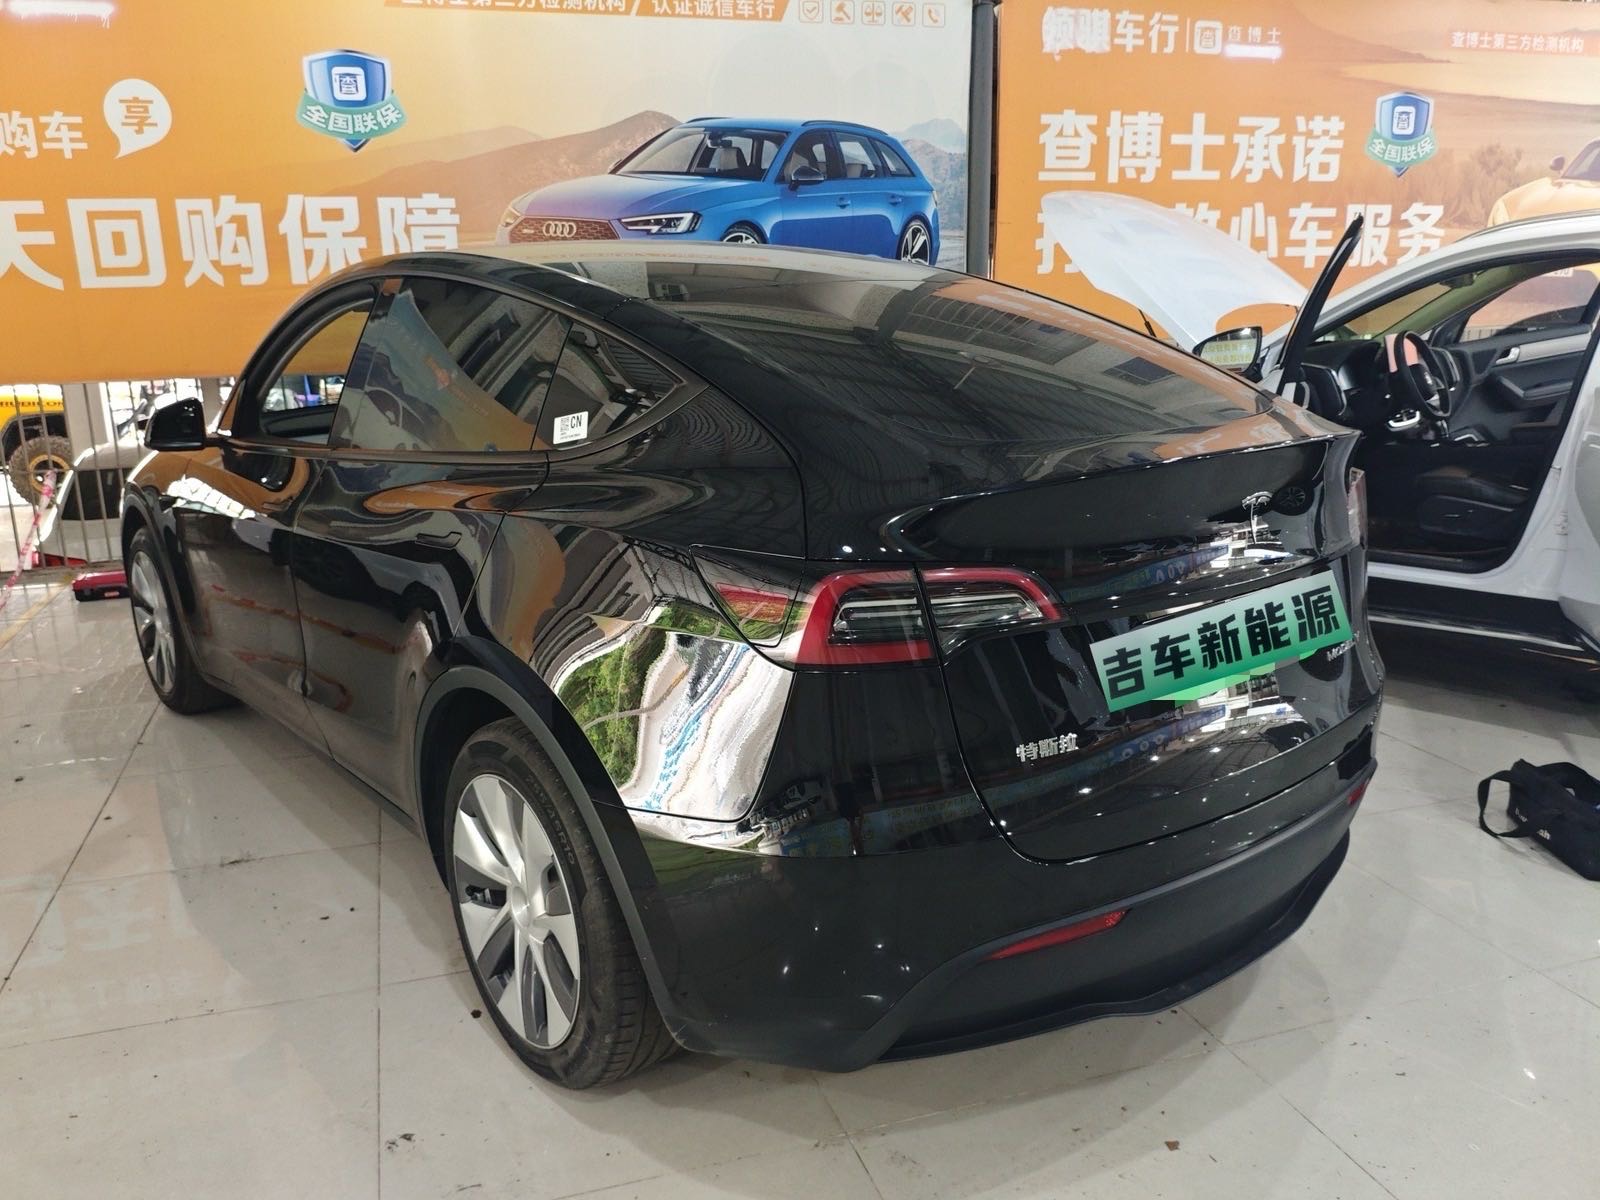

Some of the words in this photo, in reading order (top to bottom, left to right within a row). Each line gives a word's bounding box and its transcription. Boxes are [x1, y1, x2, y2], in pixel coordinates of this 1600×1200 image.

[1228, 26, 1281, 44] 查博士
[1451, 31, 1585, 53] 查博士第三方检测机构
[0, 111, 88, 159] 购车
[119, 96, 158, 136] 享
[302, 103, 402, 134] 全国联保
[1038, 109, 1345, 183] 查博士承诺
[1369, 136, 1434, 163] 全国联保
[571, 414, 582, 429] CN
[1016, 732, 1079, 763] 特斯拉
